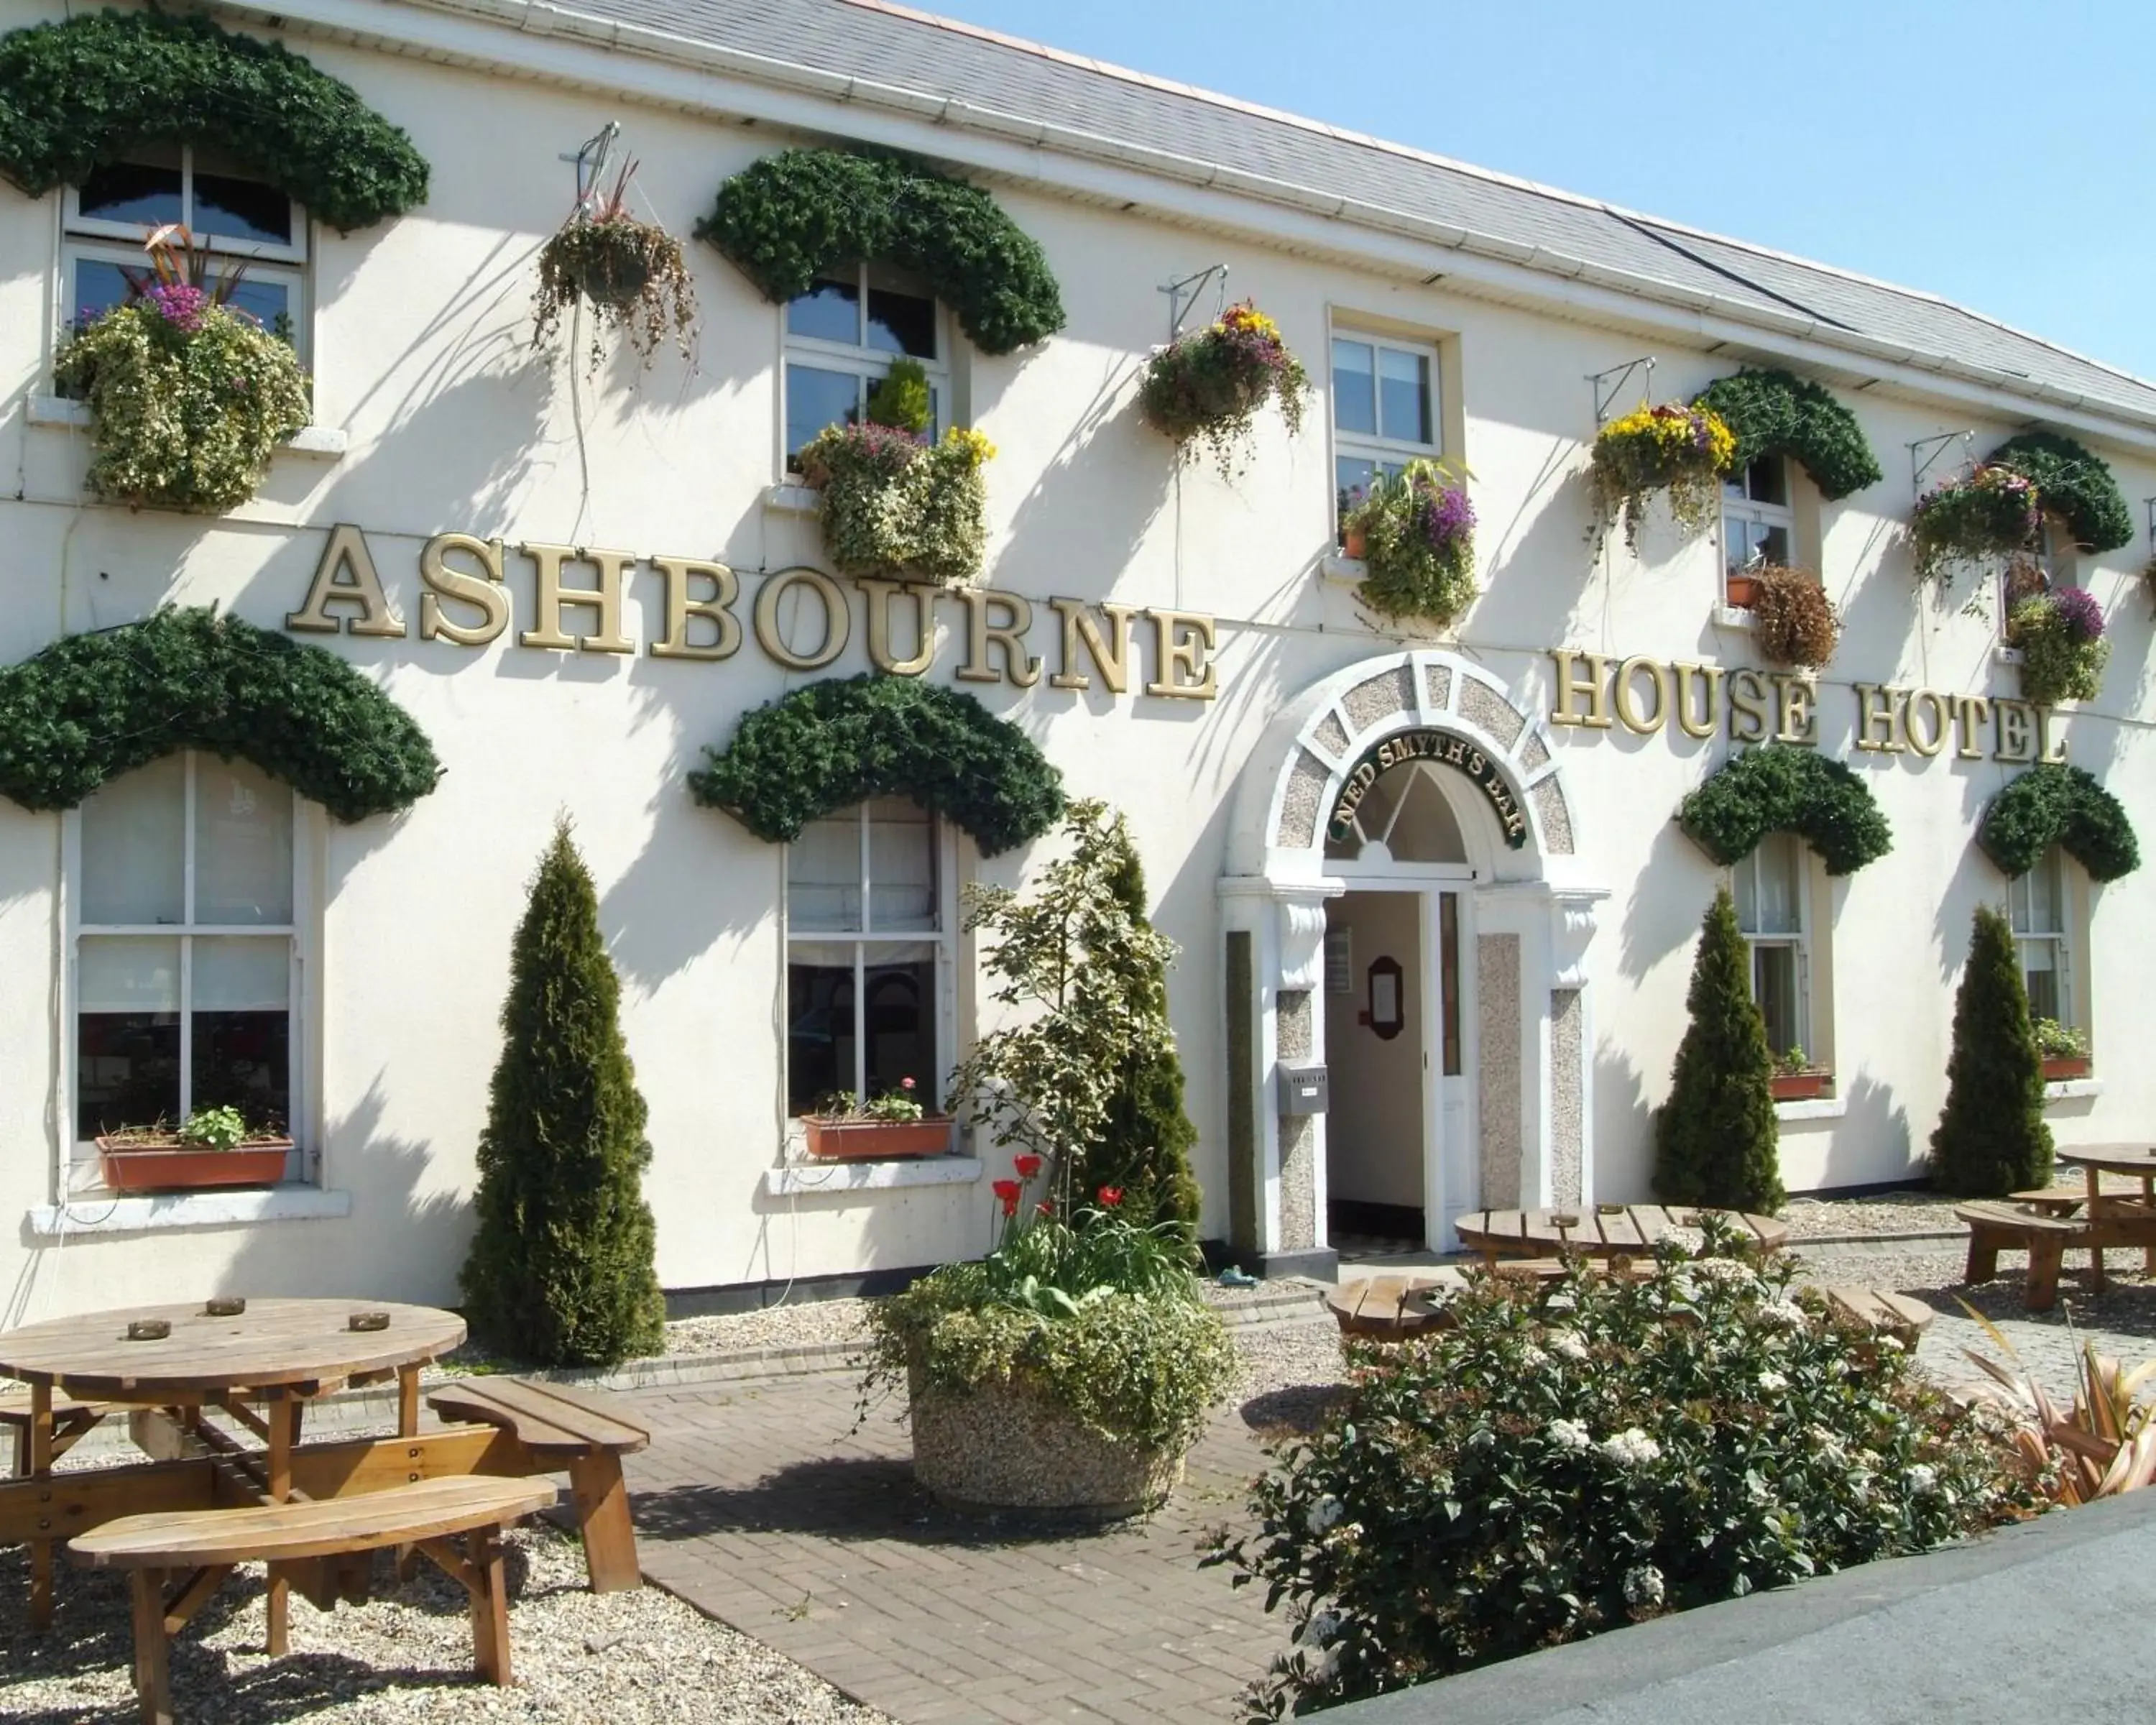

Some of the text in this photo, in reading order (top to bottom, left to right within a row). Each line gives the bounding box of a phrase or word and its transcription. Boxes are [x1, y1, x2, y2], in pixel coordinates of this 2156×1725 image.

[286, 523, 2068, 765] ASHBOURNE HOUSE HOTEL
[1334, 735, 1525, 837] NED SMYTH'S BAR
